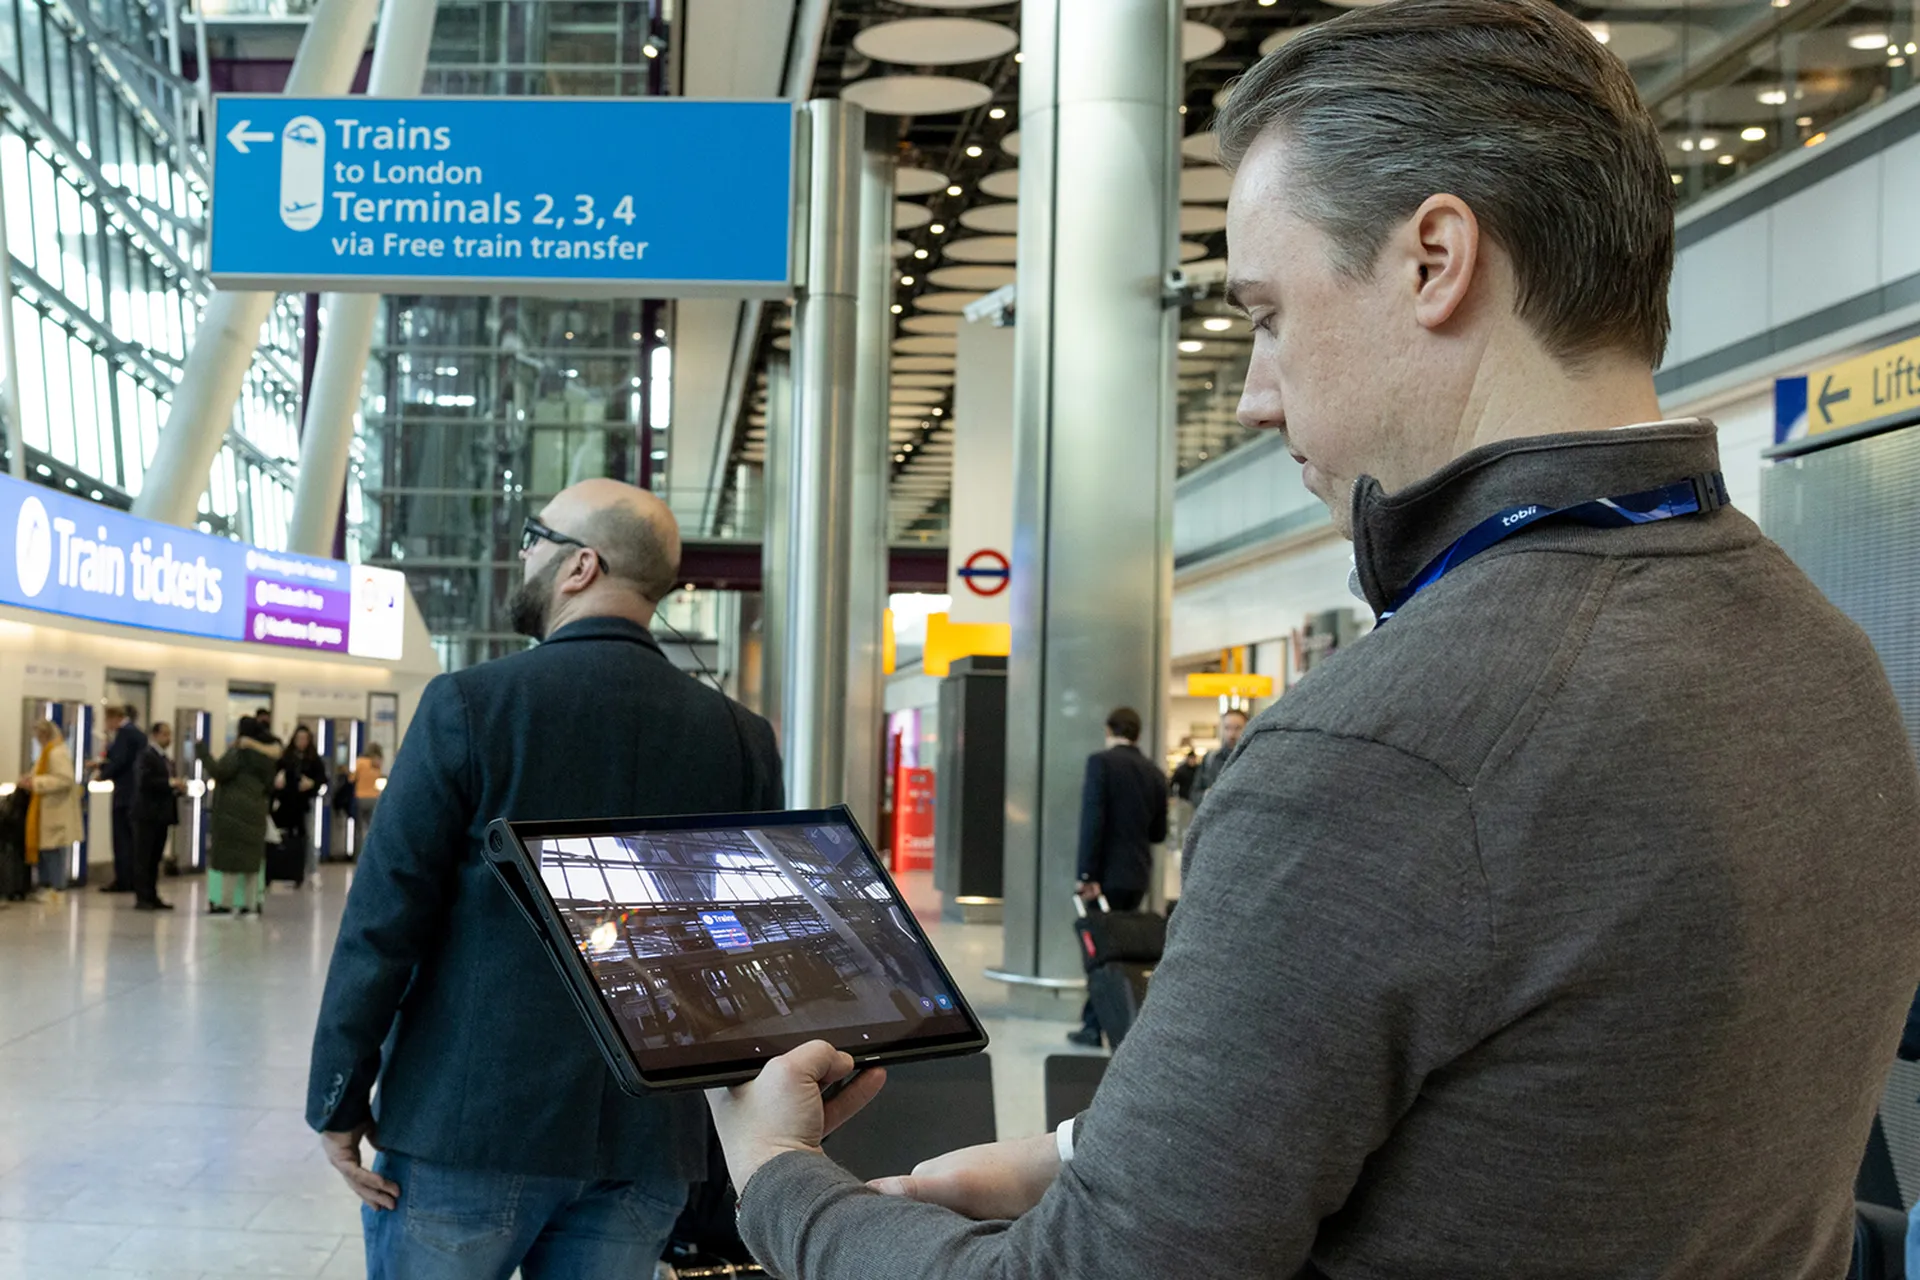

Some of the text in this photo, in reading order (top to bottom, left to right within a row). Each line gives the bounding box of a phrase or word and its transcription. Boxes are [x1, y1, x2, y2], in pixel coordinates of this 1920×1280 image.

[334, 118, 451, 151] Trains
[334, 160, 482, 184] to London
[332, 190, 636, 230] Terminals 2, 3, 4
[331, 231, 648, 260] via Free train transfer
[1502, 505, 1537, 526] tobii
[53, 517, 125, 596] Train
[130, 536, 223, 613] tickets
